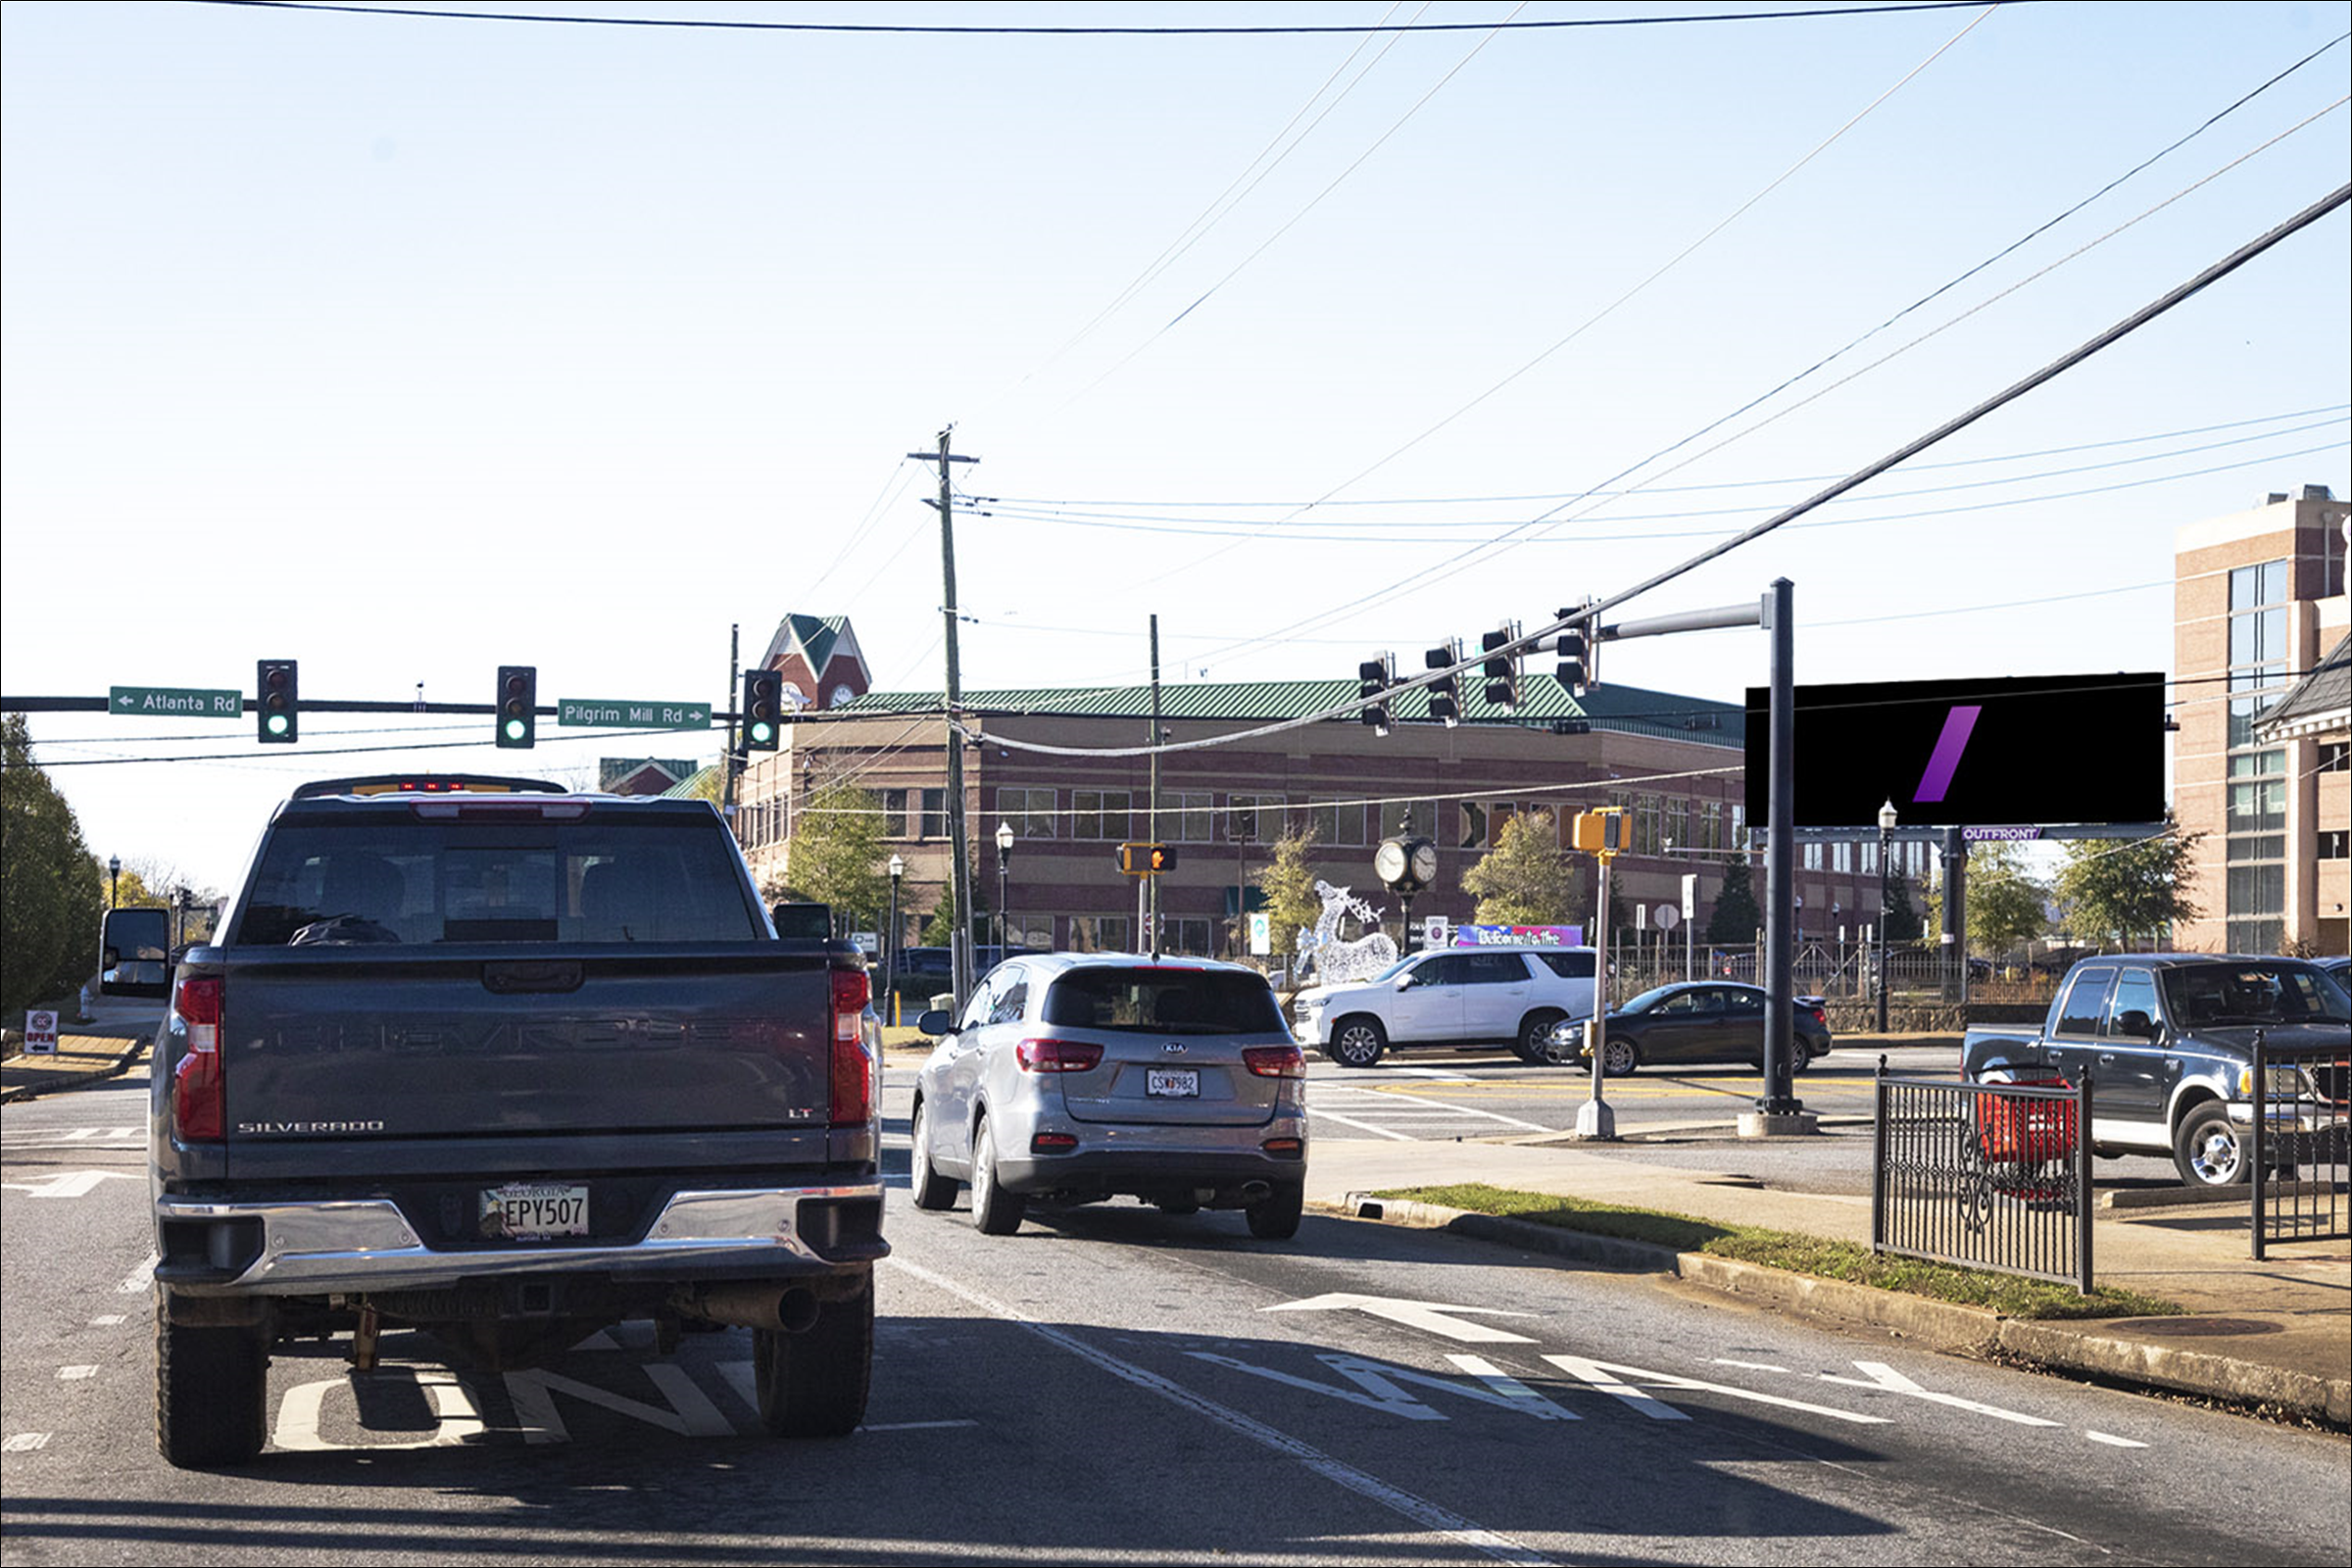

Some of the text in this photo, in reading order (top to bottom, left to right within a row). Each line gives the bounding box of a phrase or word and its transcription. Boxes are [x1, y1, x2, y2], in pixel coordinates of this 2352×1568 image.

[142, 694, 235, 711] Atlanta Rd
[564, 706, 683, 724] Pilgrim Mill Rd
[1963, 829, 2036, 839] OUTFRONT
[26, 1032, 55, 1043] OPEN
[1165, 1044, 1185, 1053] KIA
[789, 1108, 813, 1118] LT
[238, 1121, 384, 1133] SILVERADO
[506, 1198, 584, 1227] EPY507
